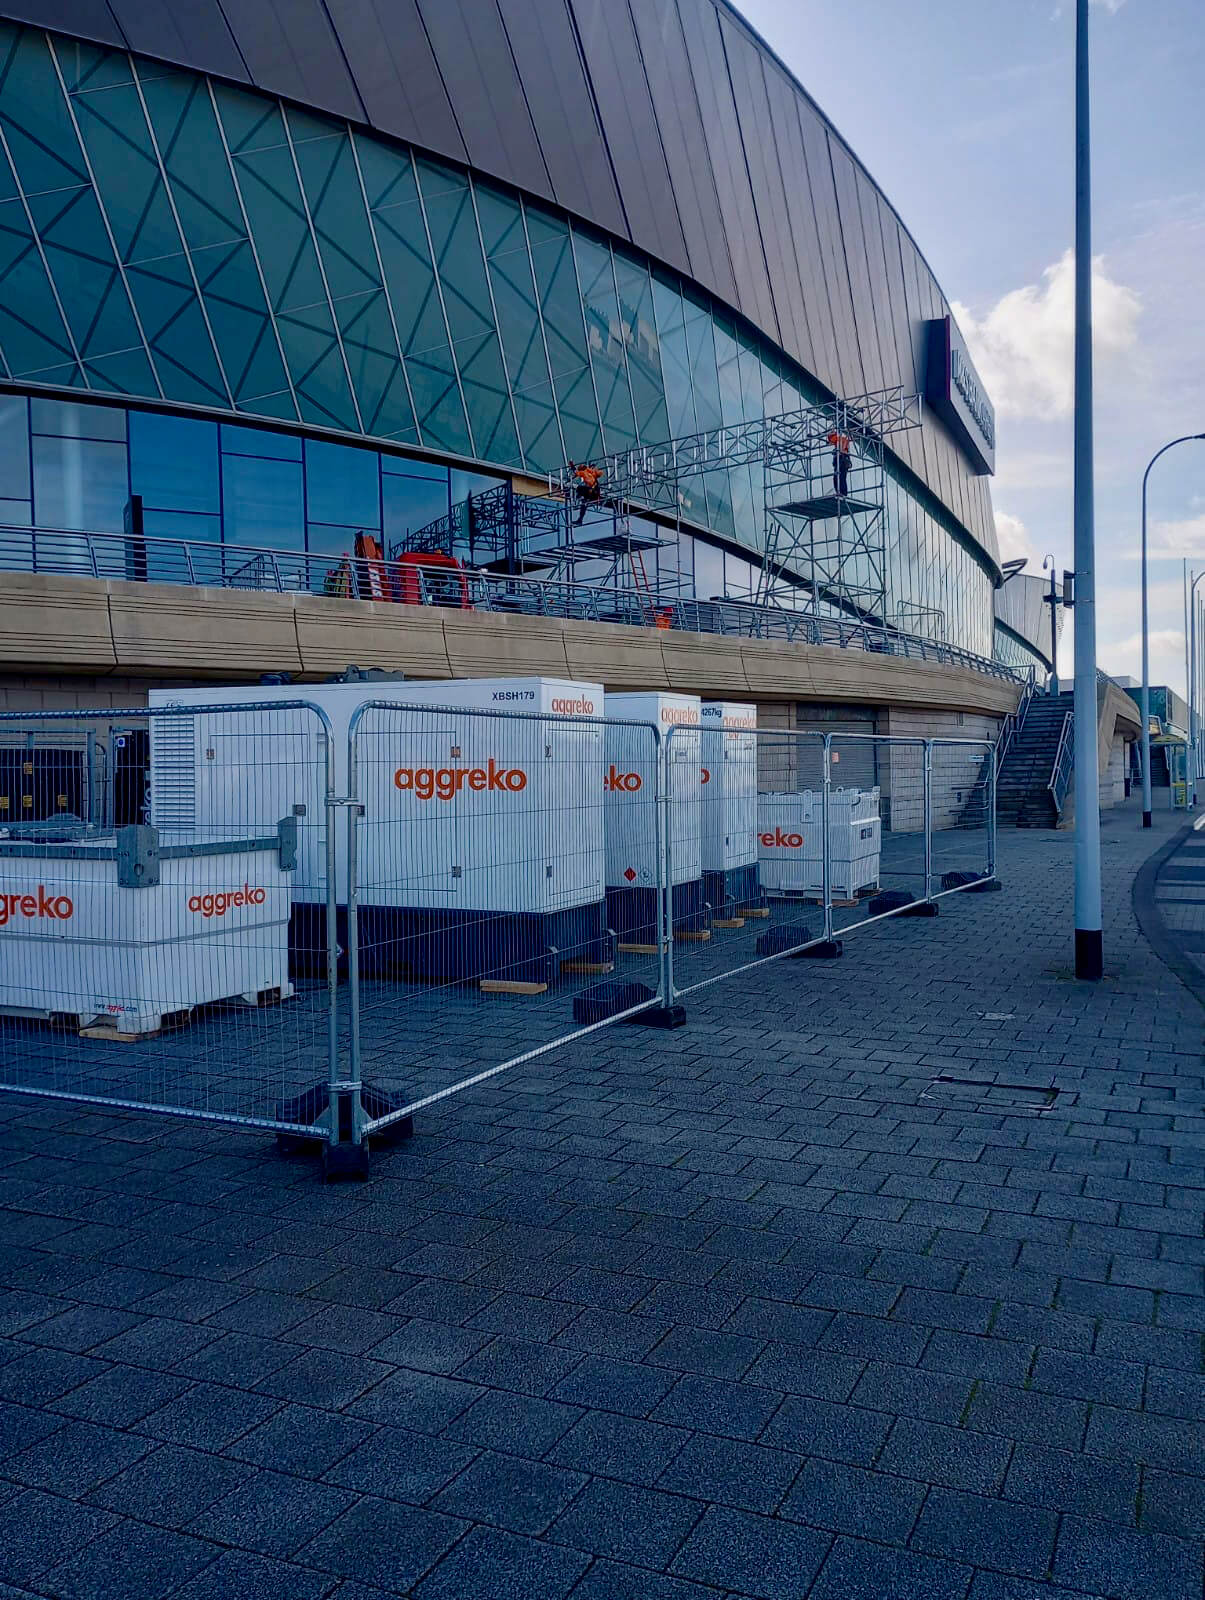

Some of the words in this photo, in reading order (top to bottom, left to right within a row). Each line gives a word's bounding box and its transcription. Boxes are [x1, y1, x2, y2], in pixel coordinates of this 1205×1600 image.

[492, 691, 535, 701] XBSH179
[551, 693, 594, 716] aggreko
[661, 706, 698, 724] aggreko
[394, 757, 527, 801] aggreko
[188, 882, 266, 918] aggreko
